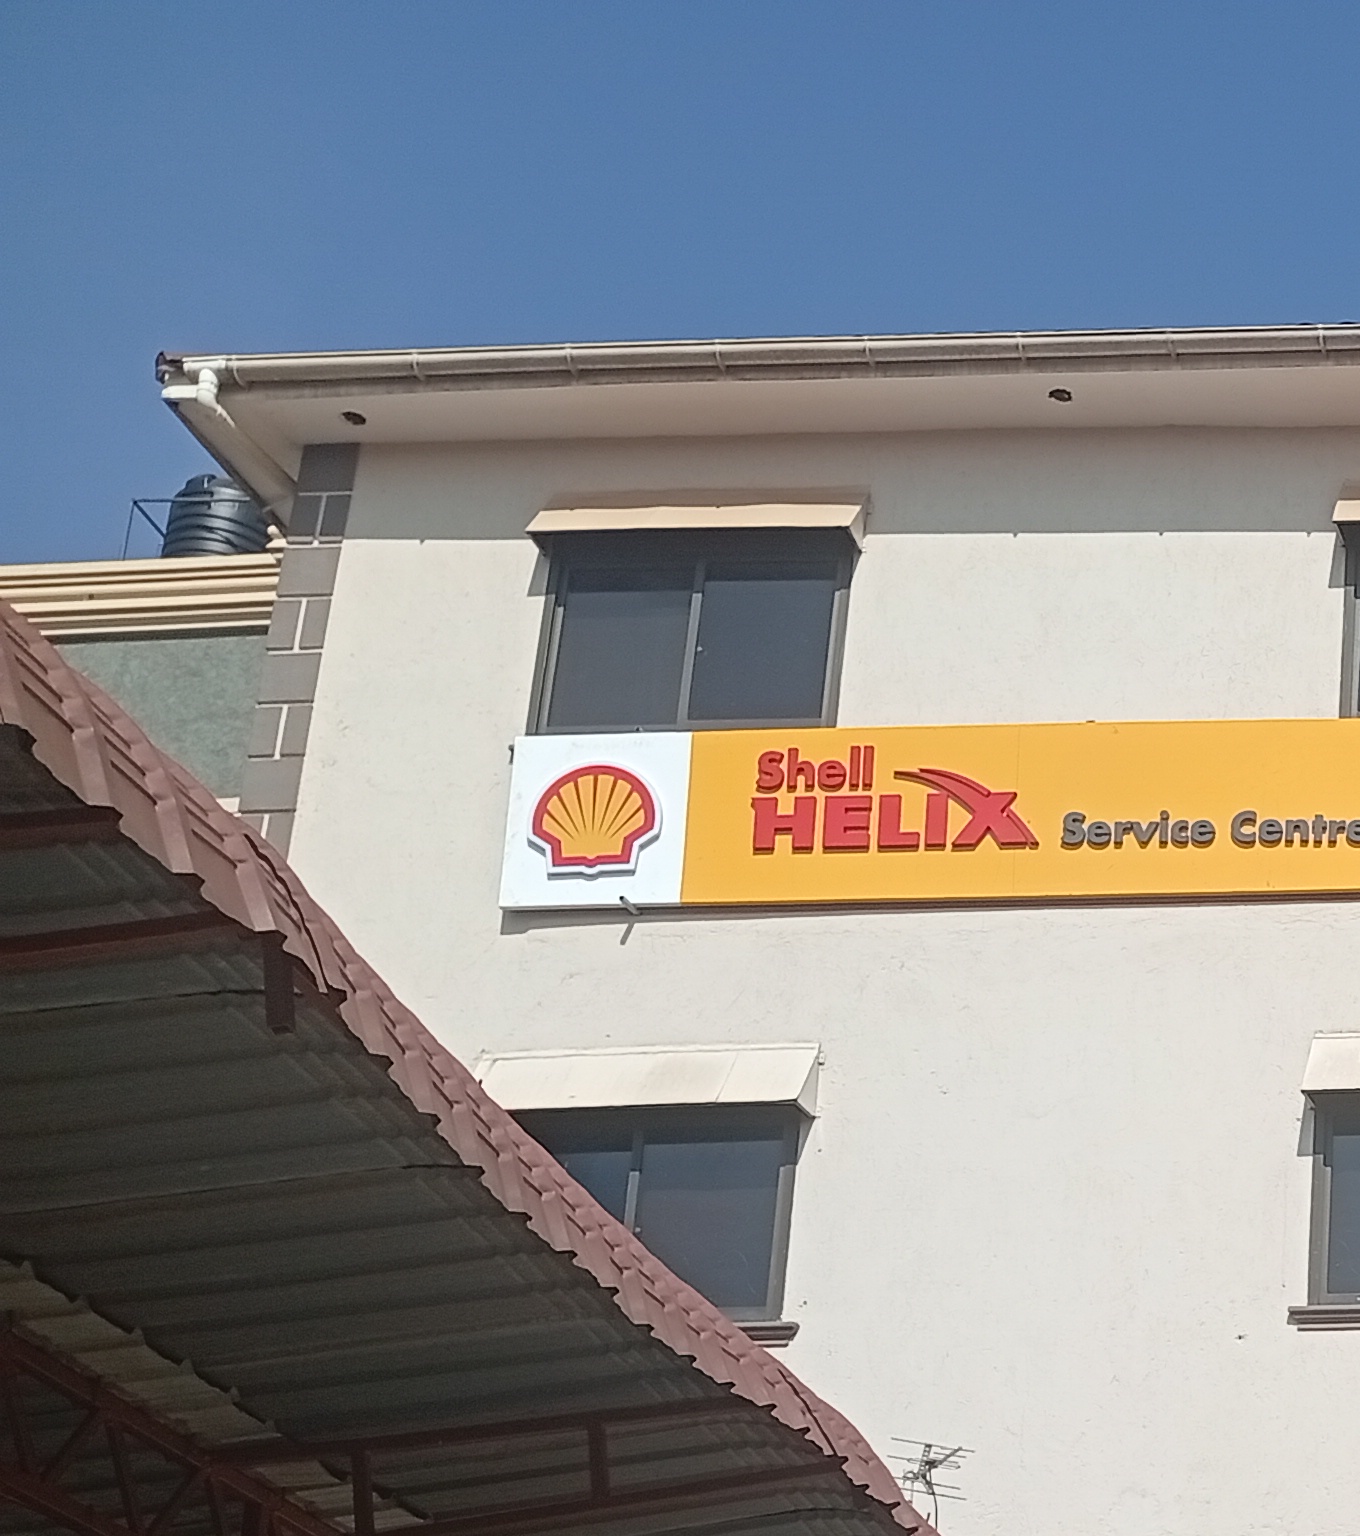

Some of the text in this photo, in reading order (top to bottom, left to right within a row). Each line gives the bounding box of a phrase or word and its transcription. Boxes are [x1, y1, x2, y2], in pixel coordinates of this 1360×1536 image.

[756, 745, 875, 793] Shell
[751, 767, 1039, 855] HELIX
[1060, 809, 1216, 850] Service
